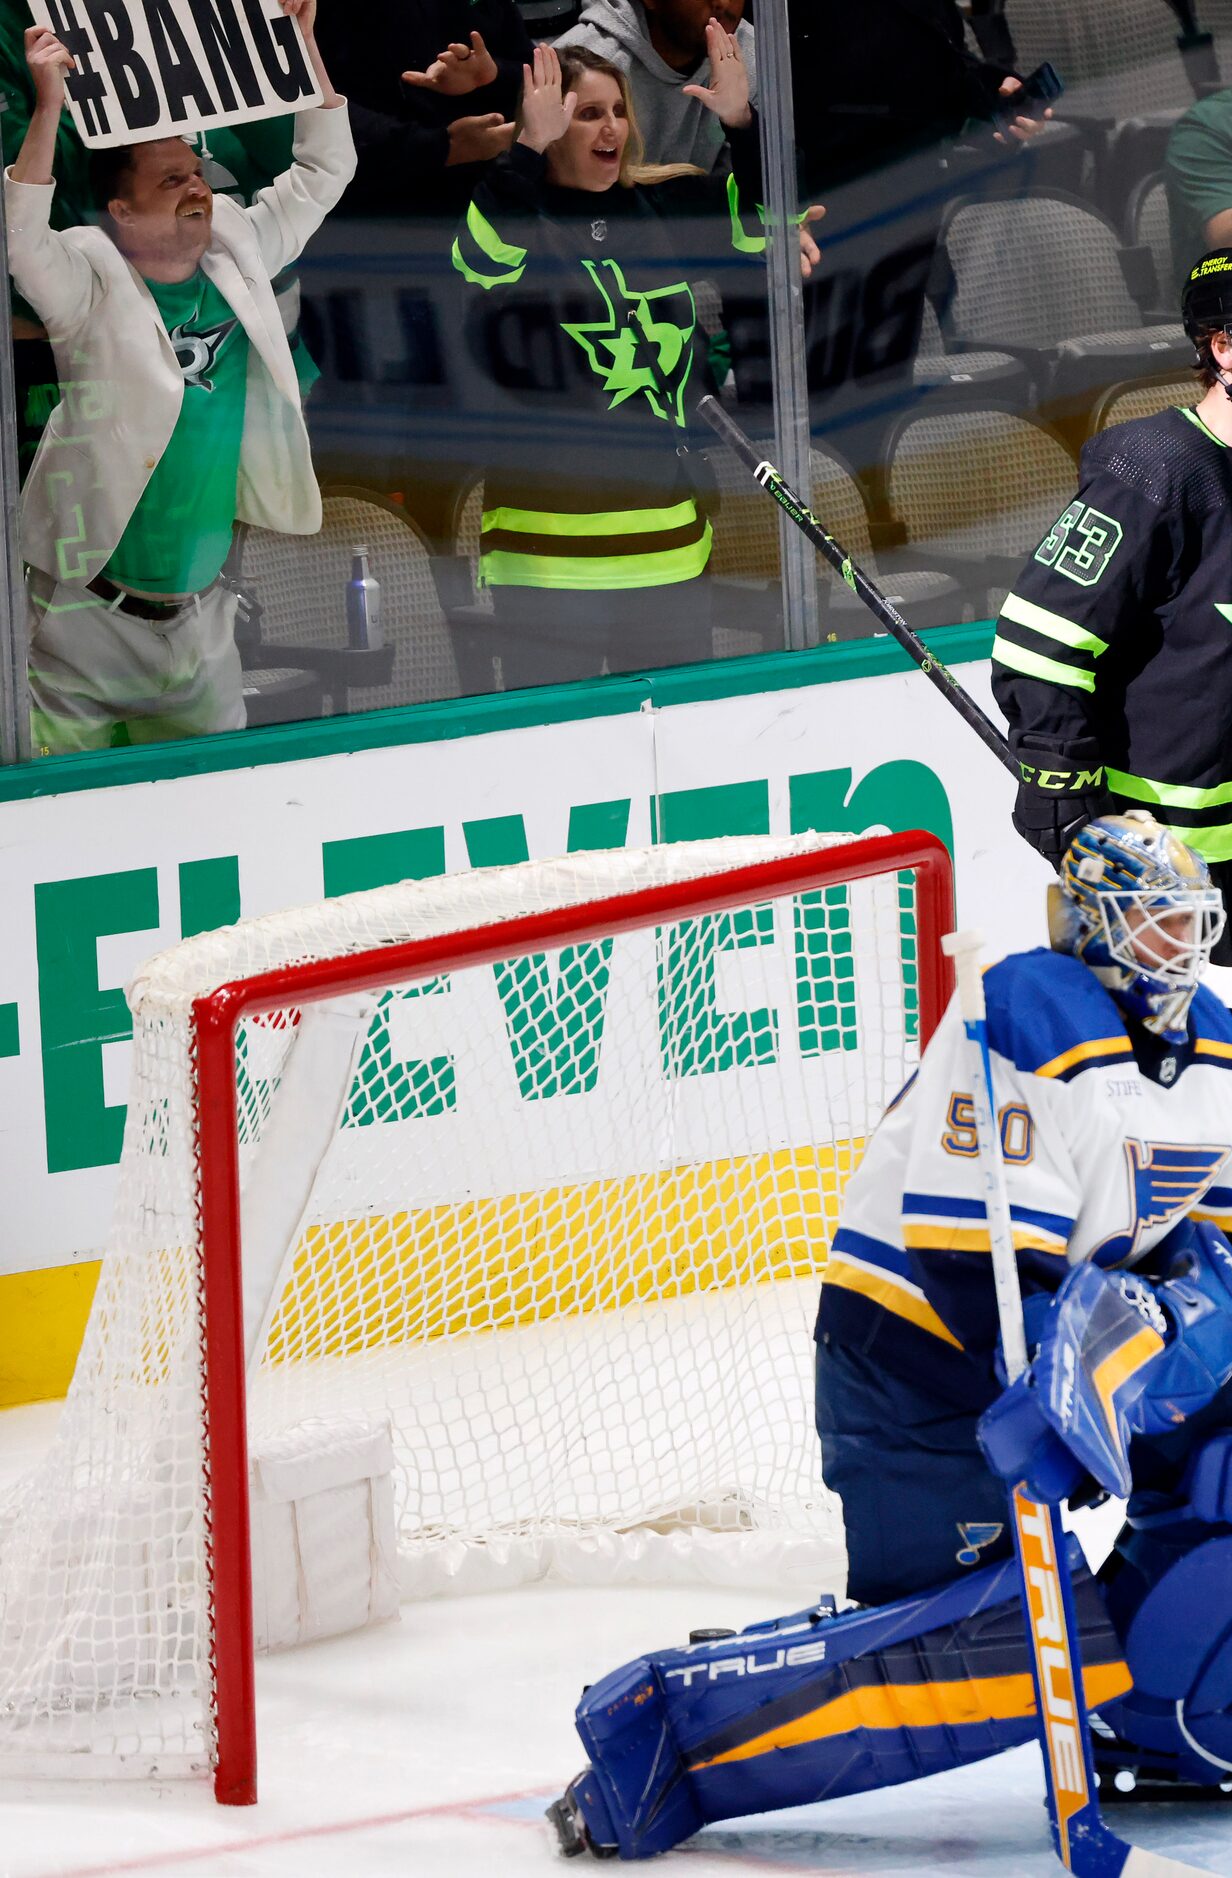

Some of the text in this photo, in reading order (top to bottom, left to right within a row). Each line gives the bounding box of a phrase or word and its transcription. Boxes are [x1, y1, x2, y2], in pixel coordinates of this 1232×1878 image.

[45, 0, 316, 137] #BANG
[1201, 256, 1228, 268] ENERGY
[1034, 500, 1124, 587] 53
[826, 632, 837, 642] 16
[40, 746, 50, 757] 15
[1019, 761, 1104, 790] CCM
[1106, 1078, 1143, 1097] STIFE
[941, 1091, 1035, 1166] 50
[665, 1641, 826, 1686] TRUE
[1020, 1503, 1084, 1795] TRUE
